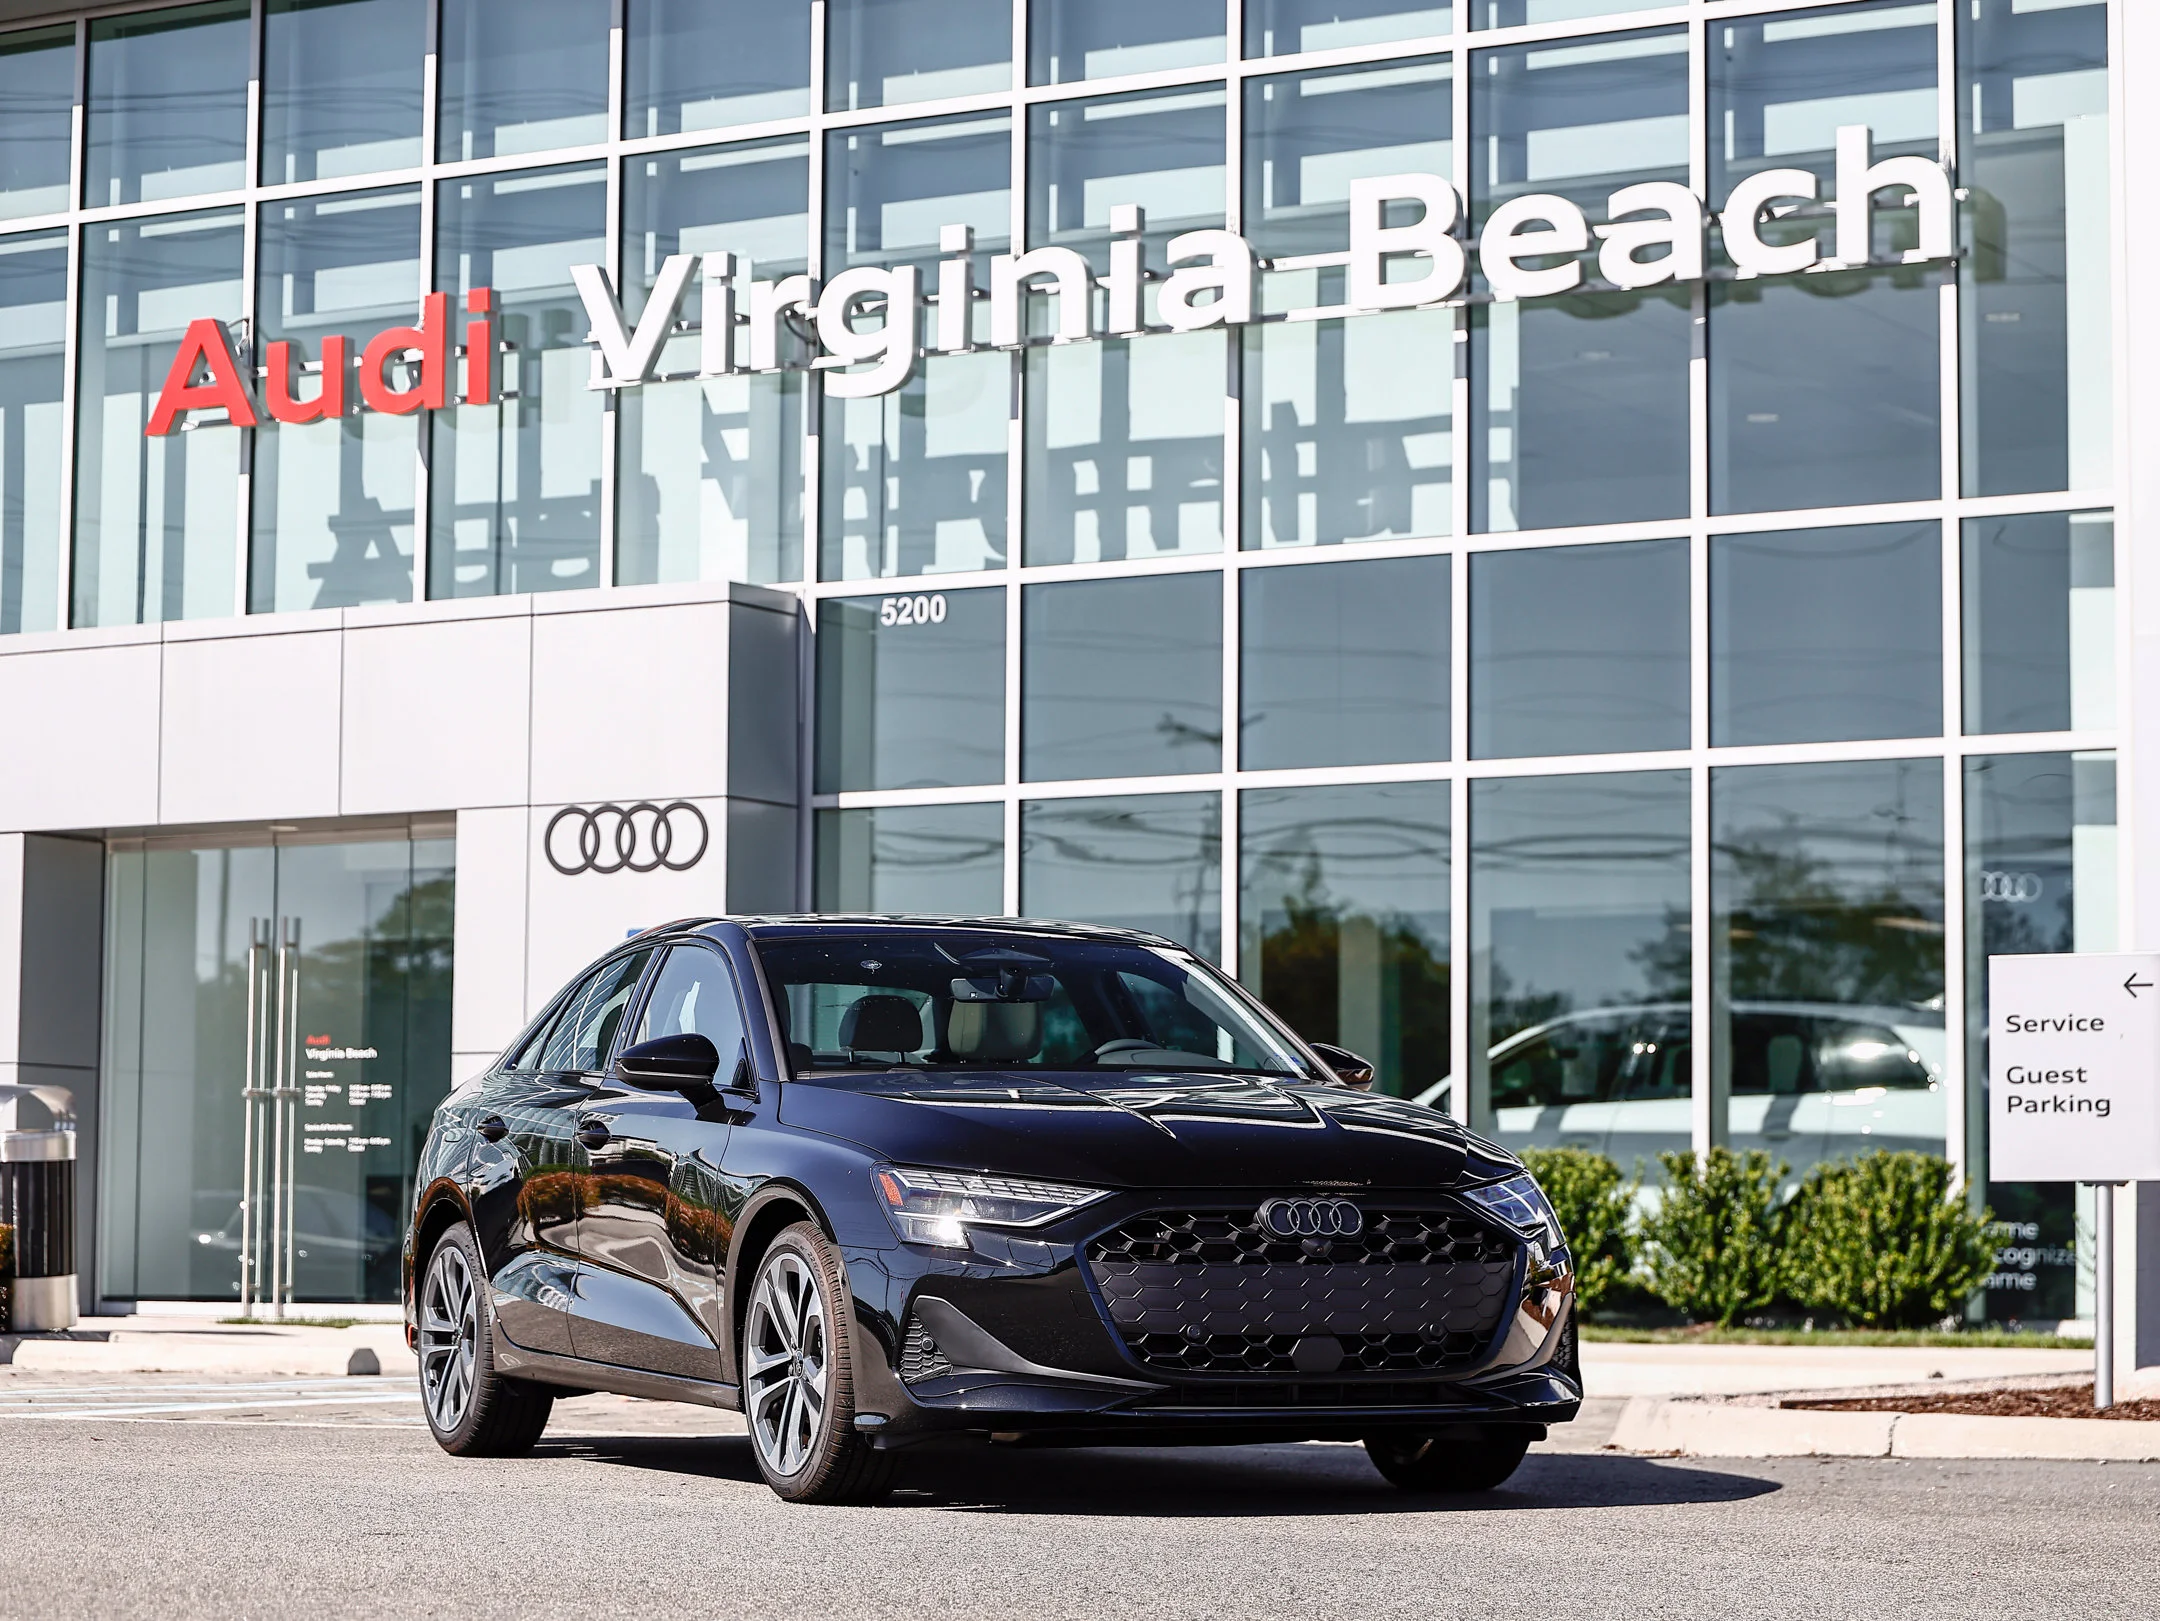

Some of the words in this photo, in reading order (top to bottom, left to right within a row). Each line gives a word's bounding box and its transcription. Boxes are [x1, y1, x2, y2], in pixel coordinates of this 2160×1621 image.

[145, 287, 503, 437] Audi
[570, 204, 1257, 399] Virginia
[1349, 124, 1955, 310] Beach
[880, 594, 947, 627] 5200
[2005, 1013, 2105, 1033] Service
[305, 1047, 345, 1062] Virginia
[345, 1046, 378, 1059] Beach
[2006, 1065, 2088, 1084] Guest
[2007, 1094, 2111, 1118] Parking
